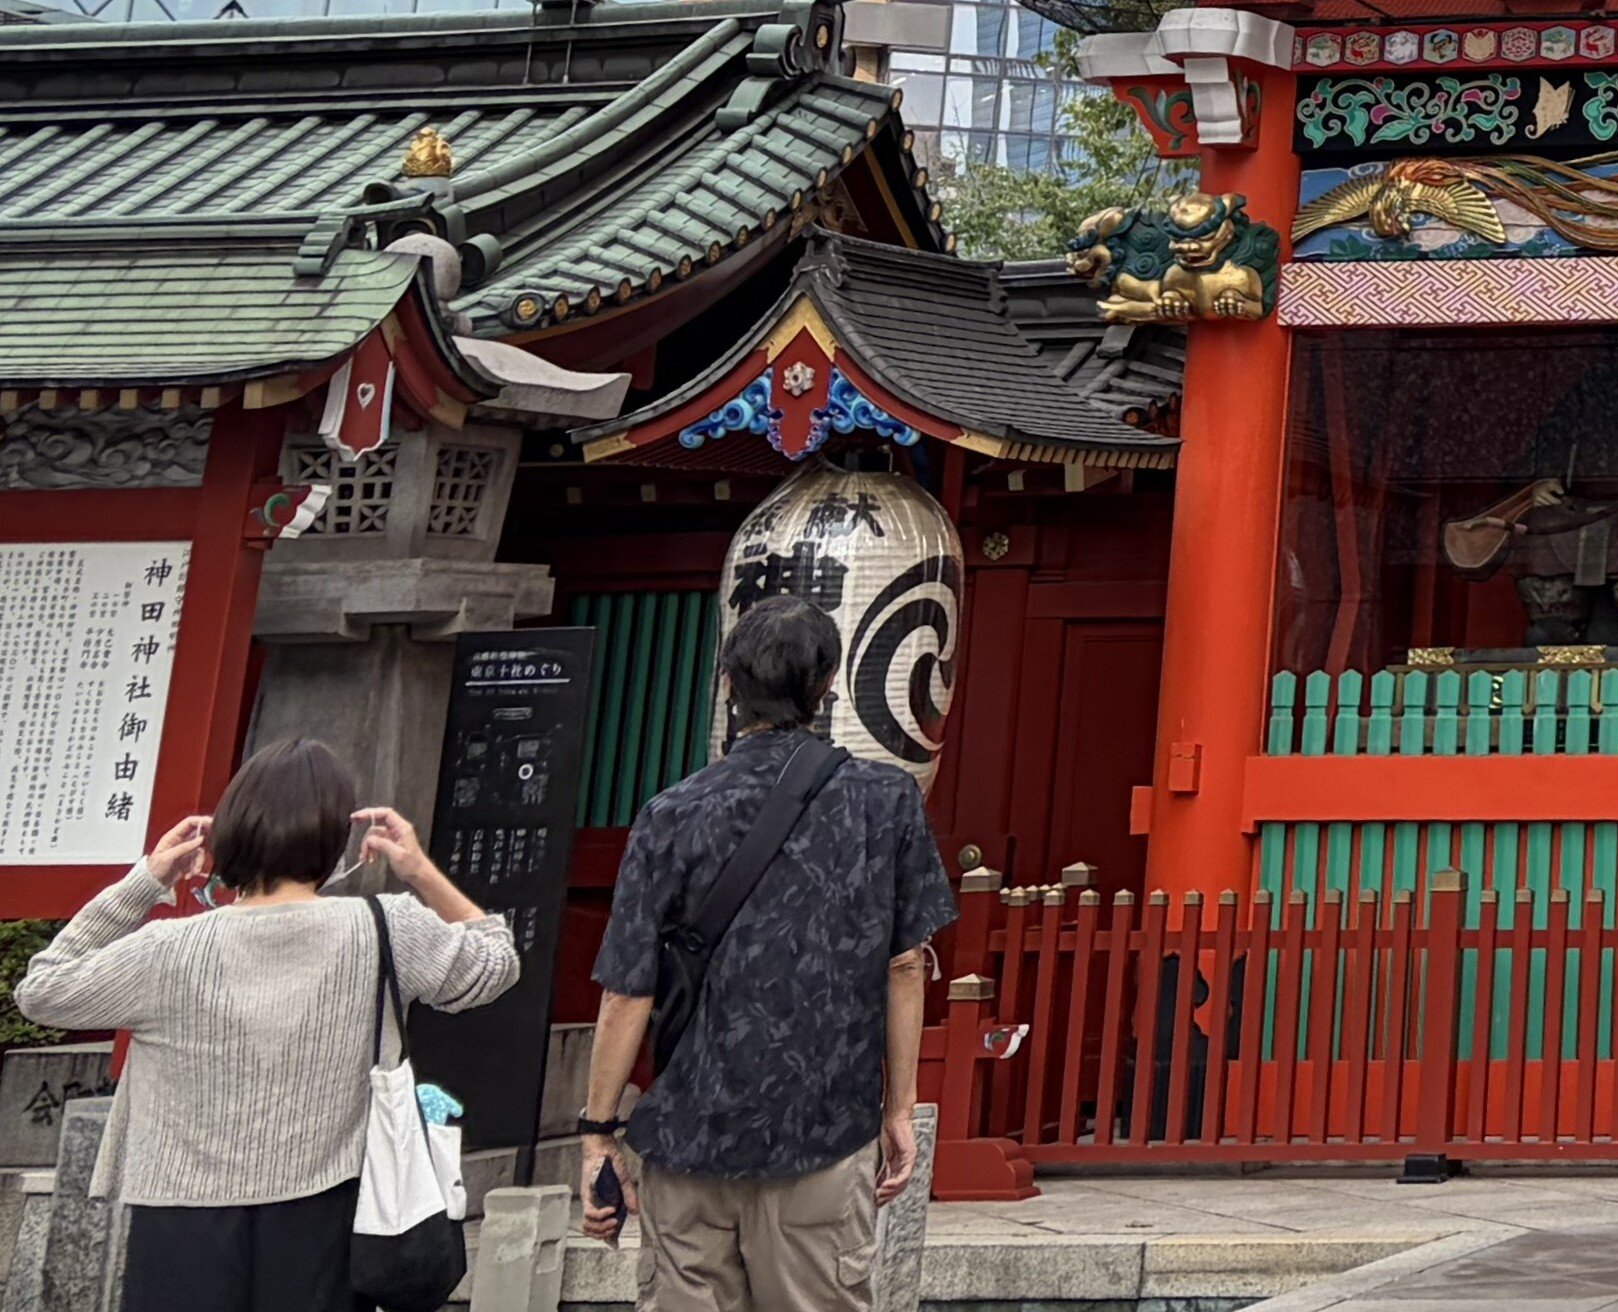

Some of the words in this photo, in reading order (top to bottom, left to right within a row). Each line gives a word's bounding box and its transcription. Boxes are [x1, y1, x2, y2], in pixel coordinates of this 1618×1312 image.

[105, 558, 173, 822] 神田神社御由緒
